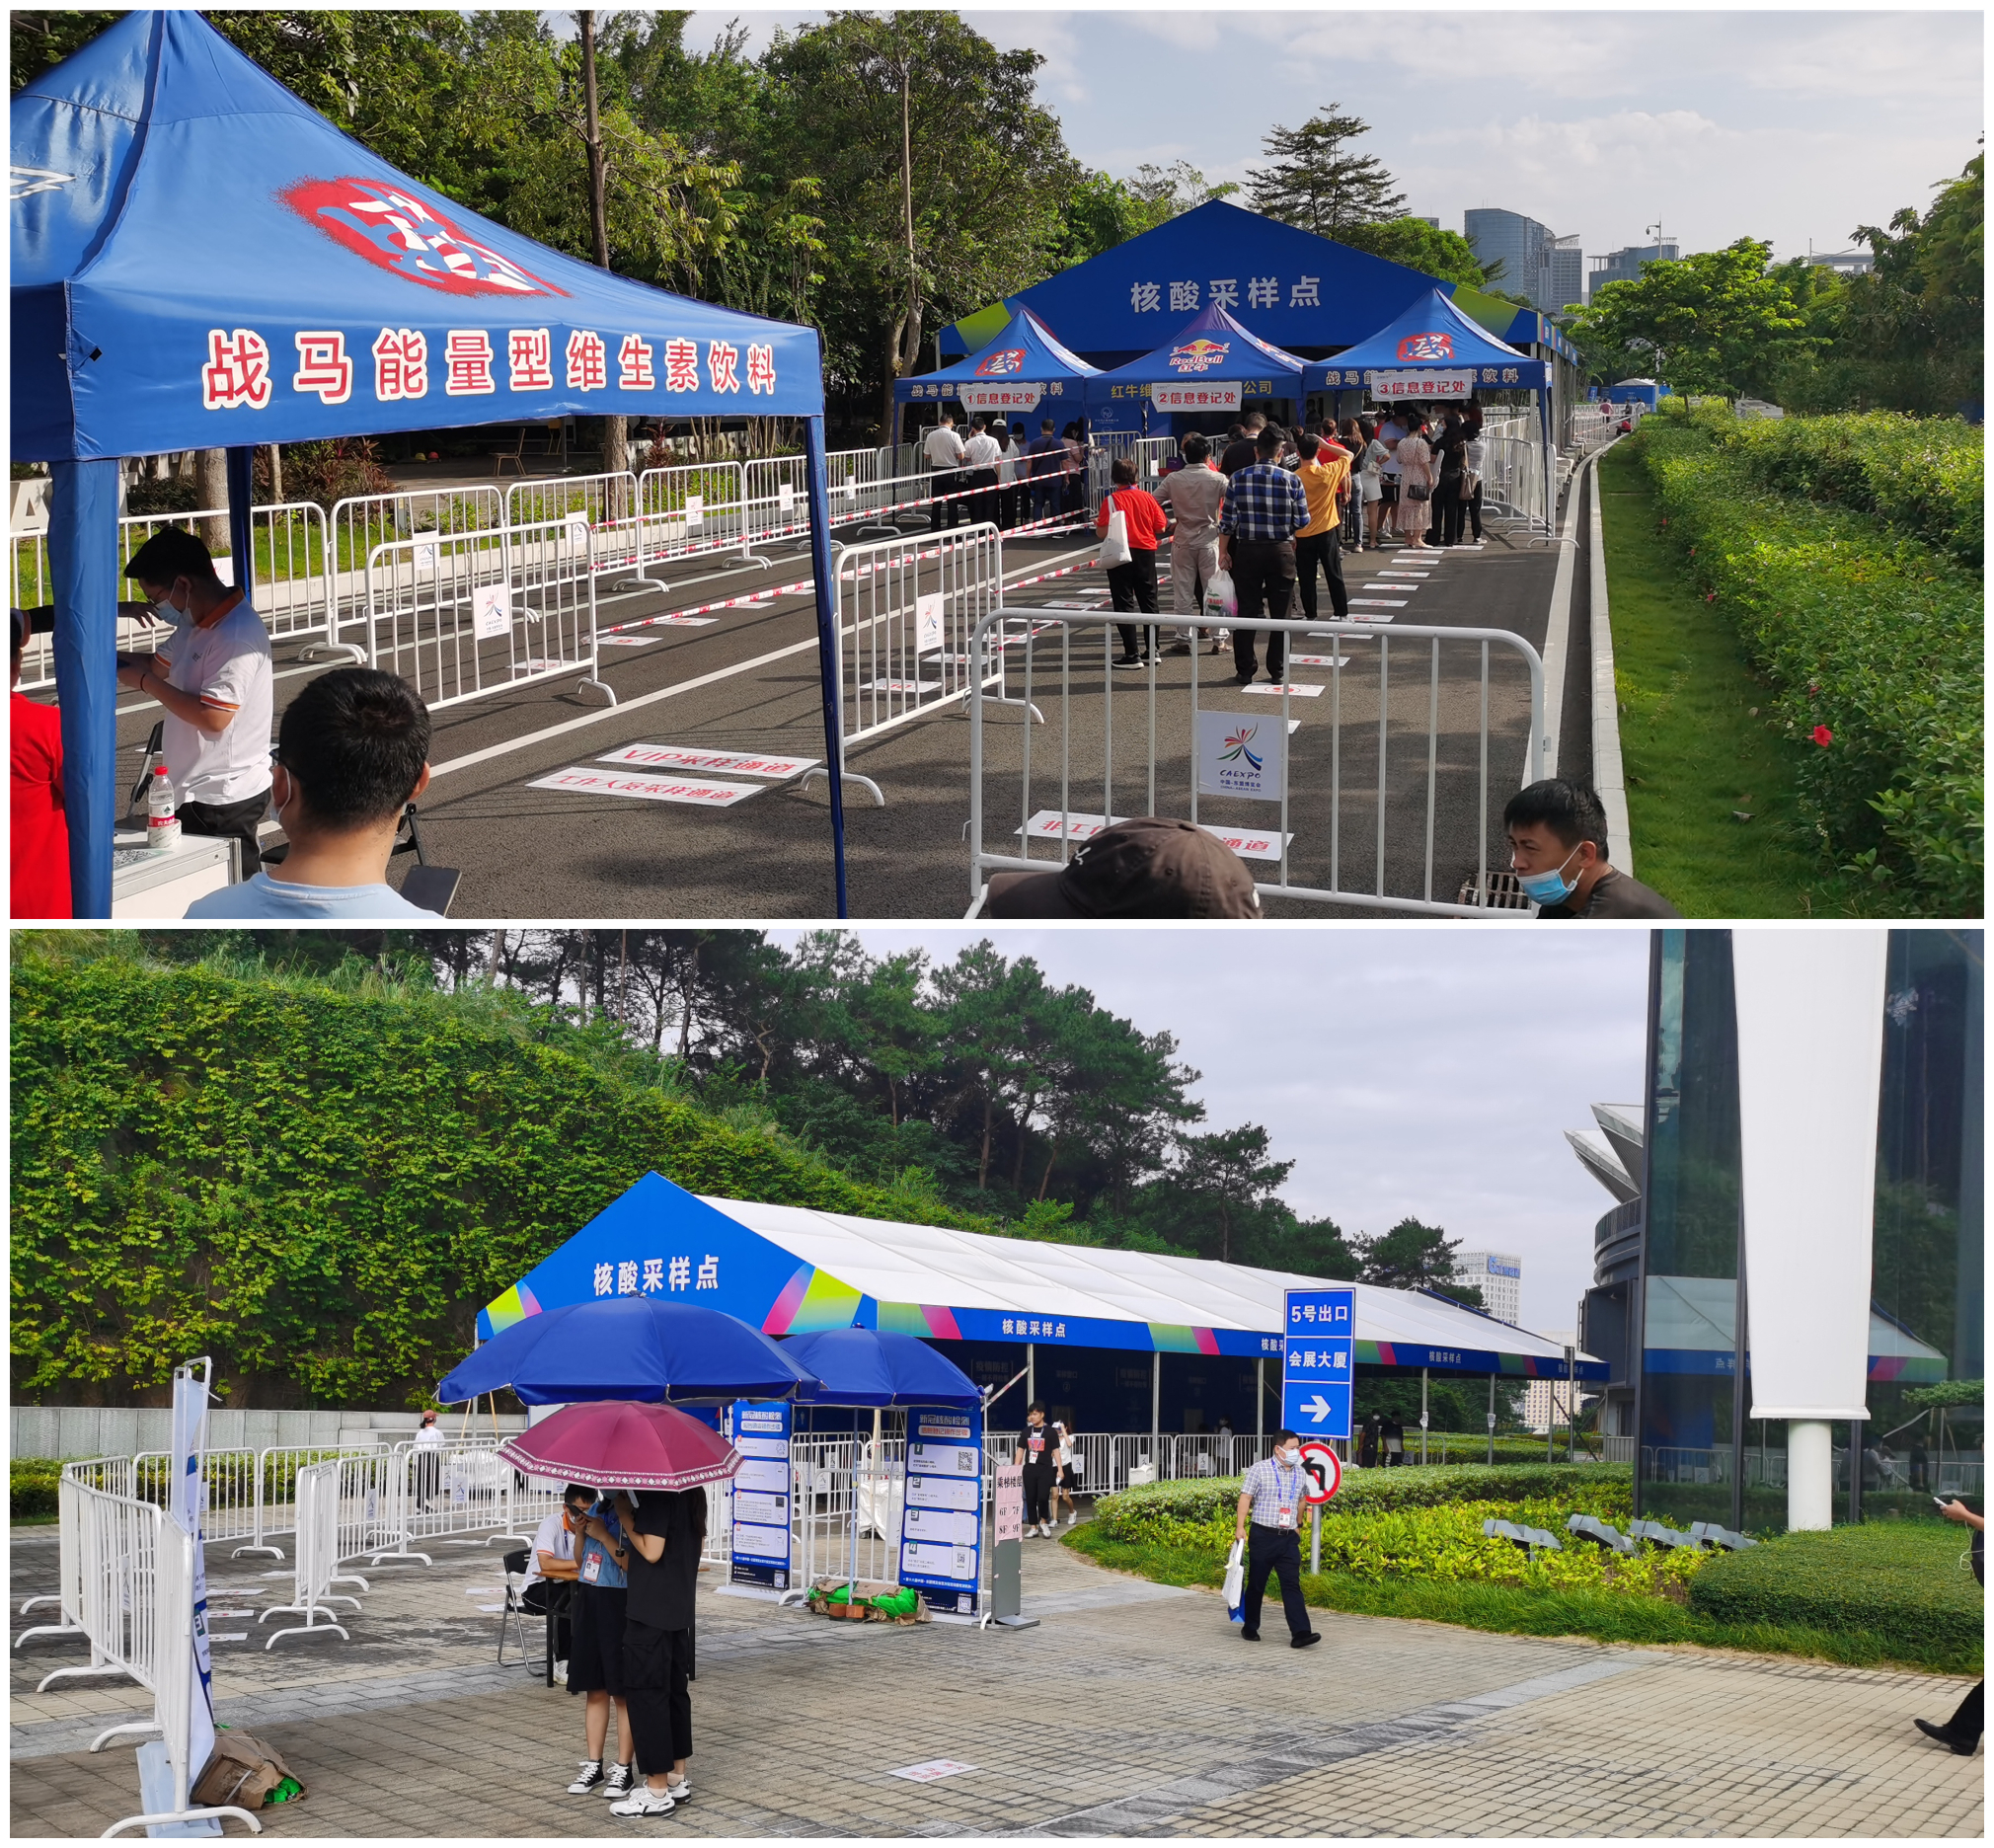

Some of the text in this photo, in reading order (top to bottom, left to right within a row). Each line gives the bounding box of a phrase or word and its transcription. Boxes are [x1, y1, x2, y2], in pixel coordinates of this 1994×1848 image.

[1130, 274, 1322, 313] 核酸采样点
[201, 328, 777, 411] 战马能量型维生素饮料
[1169, 354, 1224, 366] RedBull
[1178, 363, 1209, 373] 红牛
[622, 749, 797, 775] VIP采样通道
[1219, 769, 1262, 780] CAEXPO
[549, 774, 740, 801] 工作人员采样通道
[593, 1254, 720, 1297] 核酸采样点
[1291, 1304, 1348, 1323] 5号出口
[1002, 1318, 1067, 1339] 核酸采样点
[1288, 1350, 1348, 1369] 会展大厦
[1428, 1349, 1462, 1364] 核酸采样点
[999, 1505, 1021, 1516] 6F 7F
[999, 1523, 1021, 1535] 8F 9F
